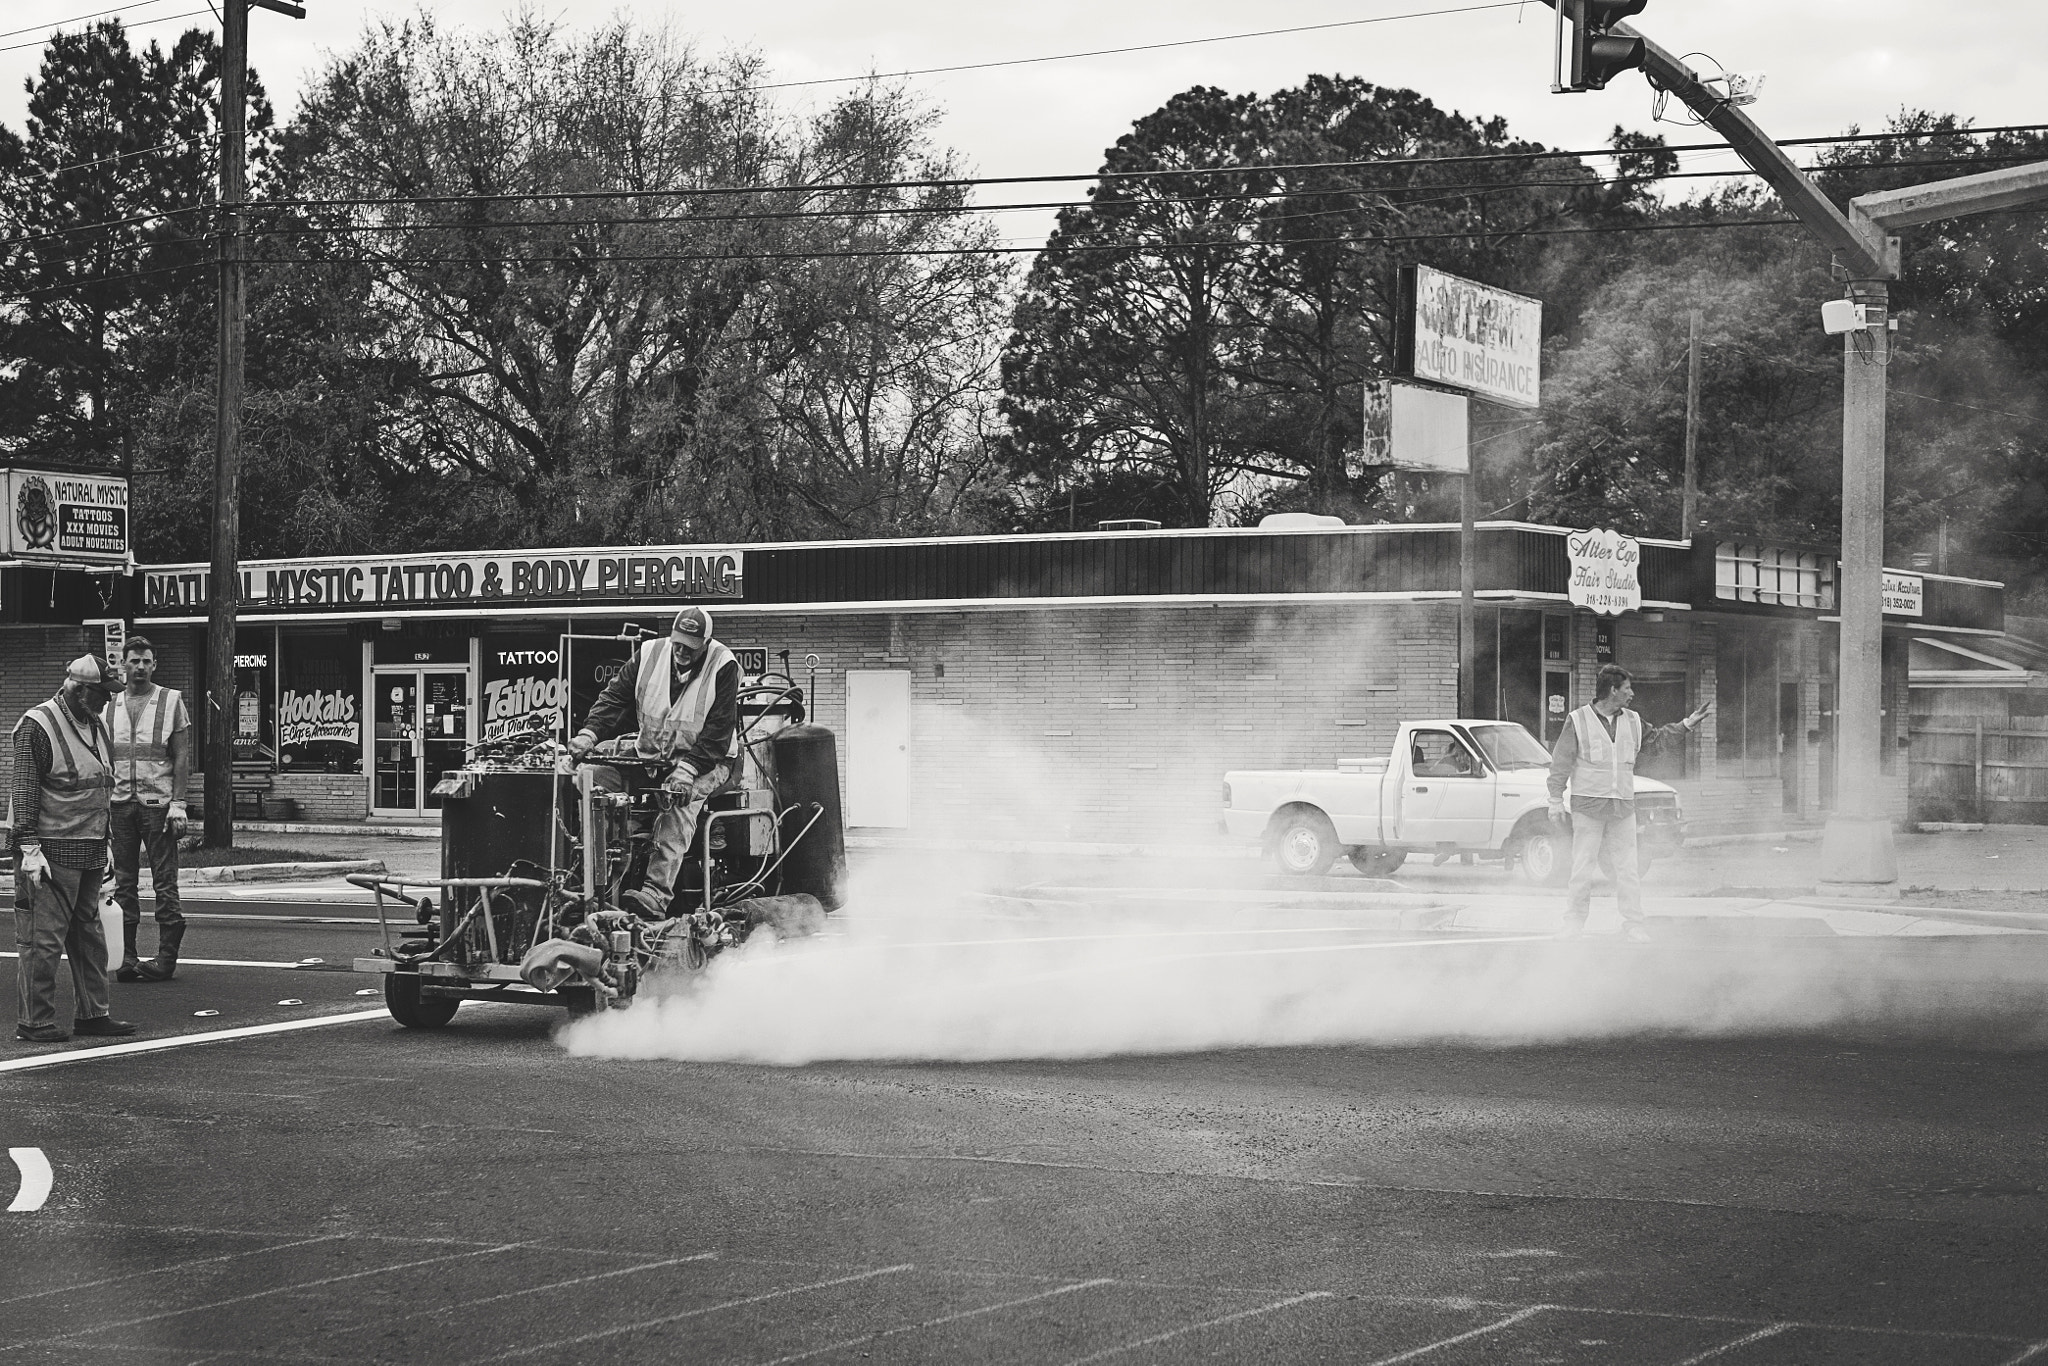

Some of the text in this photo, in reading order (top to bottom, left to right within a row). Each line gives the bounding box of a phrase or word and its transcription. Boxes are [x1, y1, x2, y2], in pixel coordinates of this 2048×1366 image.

[1419, 340, 1533, 395] AUTO INSURANCE
[55, 481, 127, 505] NATURAL MYSTIC
[72, 508, 113, 522] TATTOOS
[66, 522, 119, 536] XXX MOVIES
[61, 535, 125, 551] ADULT NOVELTIES
[1570, 537, 1637, 567] Alter Ego
[267, 566, 364, 605] MYSTIC
[370, 562, 474, 604] TATTOO
[480, 561, 503, 597] &
[512, 558, 590, 597] BODY
[598, 555, 736, 595] PIERCING
[1574, 565, 1636, 590] Hair Studio
[1598, 634, 1608, 643] 121
[233, 654, 267, 668] PIERCING
[497, 650, 559, 665] TATTOO
[735, 652, 762, 670] OOS
[594, 665, 621, 683] OPE
[280, 690, 355, 725] Hookahs
[484, 676, 568, 721] Tattoos
[311, 724, 355, 739] Accessories
